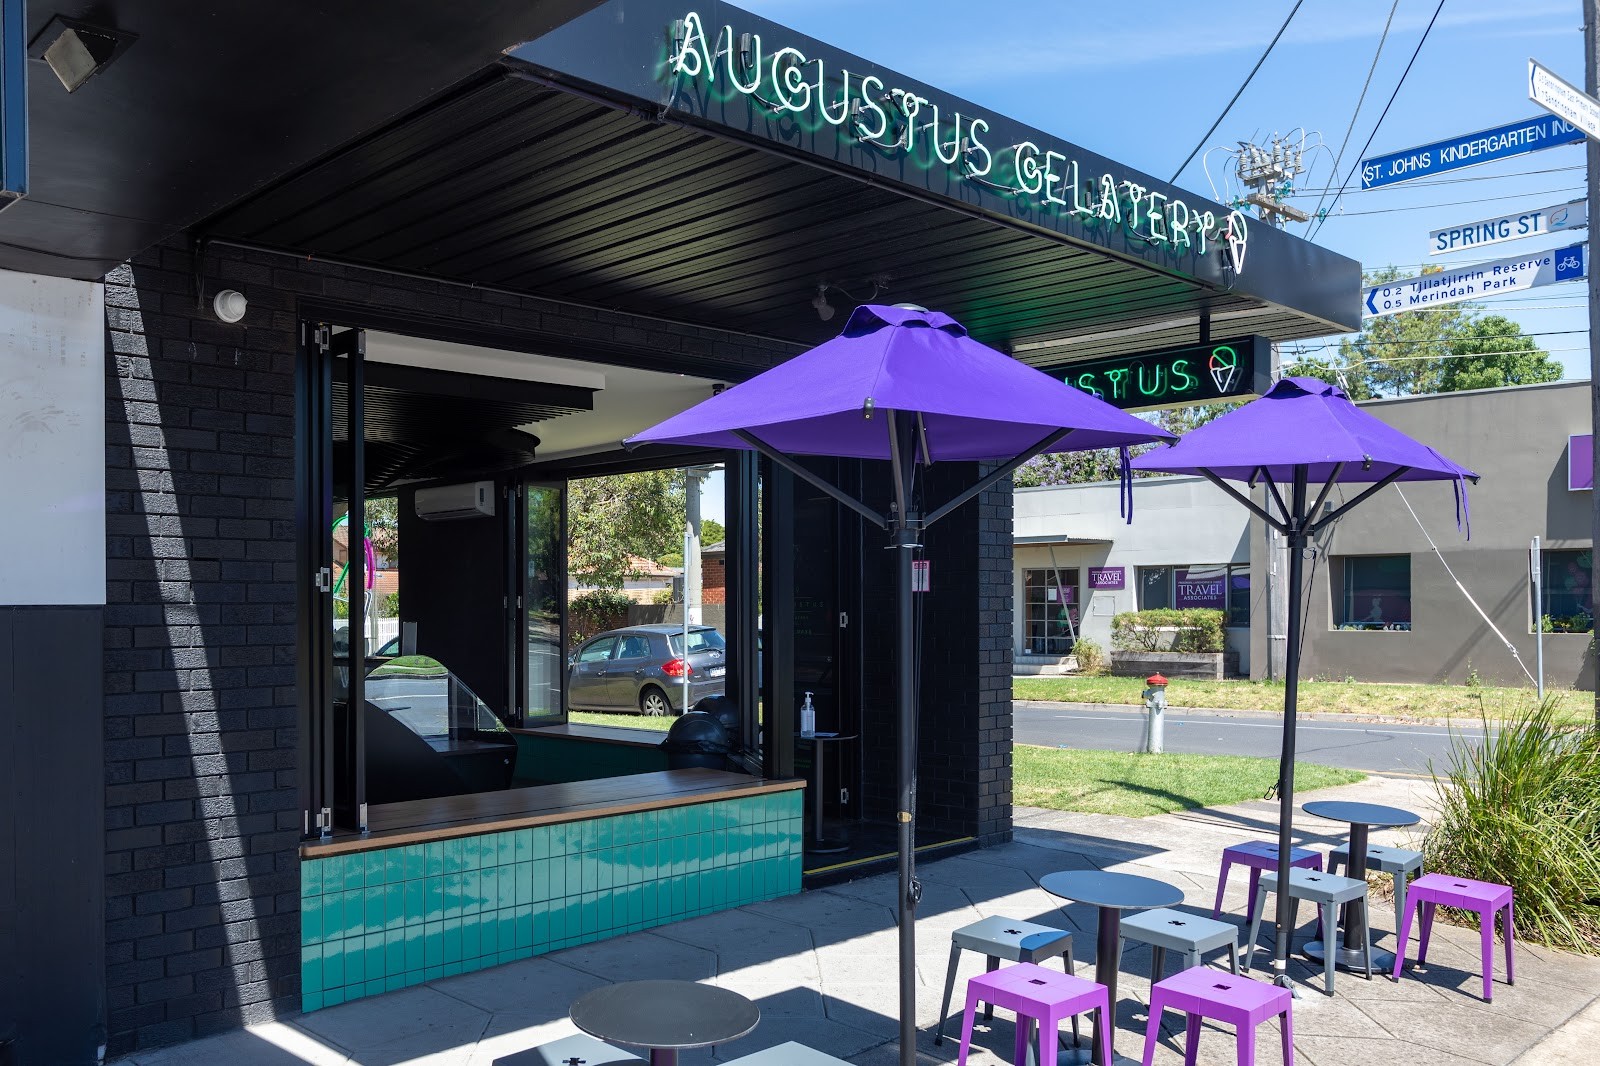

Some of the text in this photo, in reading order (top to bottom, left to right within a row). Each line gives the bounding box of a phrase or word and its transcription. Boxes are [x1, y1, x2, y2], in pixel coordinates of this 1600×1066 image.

[676, 12, 1214, 255] AUGUSTUS GELATERY
[1366, 164, 1384, 182] ST.
[1388, 153, 1431, 176] JOHNS
[1440, 123, 1546, 164] KINDERGARTEN
[1436, 213, 1542, 250] SPRING ST
[1383, 257, 1551, 298] 0.2 Tjilatjirrin Reserve
[1383, 276, 1517, 310] 0.5 Merindah Park
[1065, 359, 1190, 399] STUS
[1091, 572, 1122, 582] TRAVEL
[1178, 584, 1223, 595] TRAVEL
